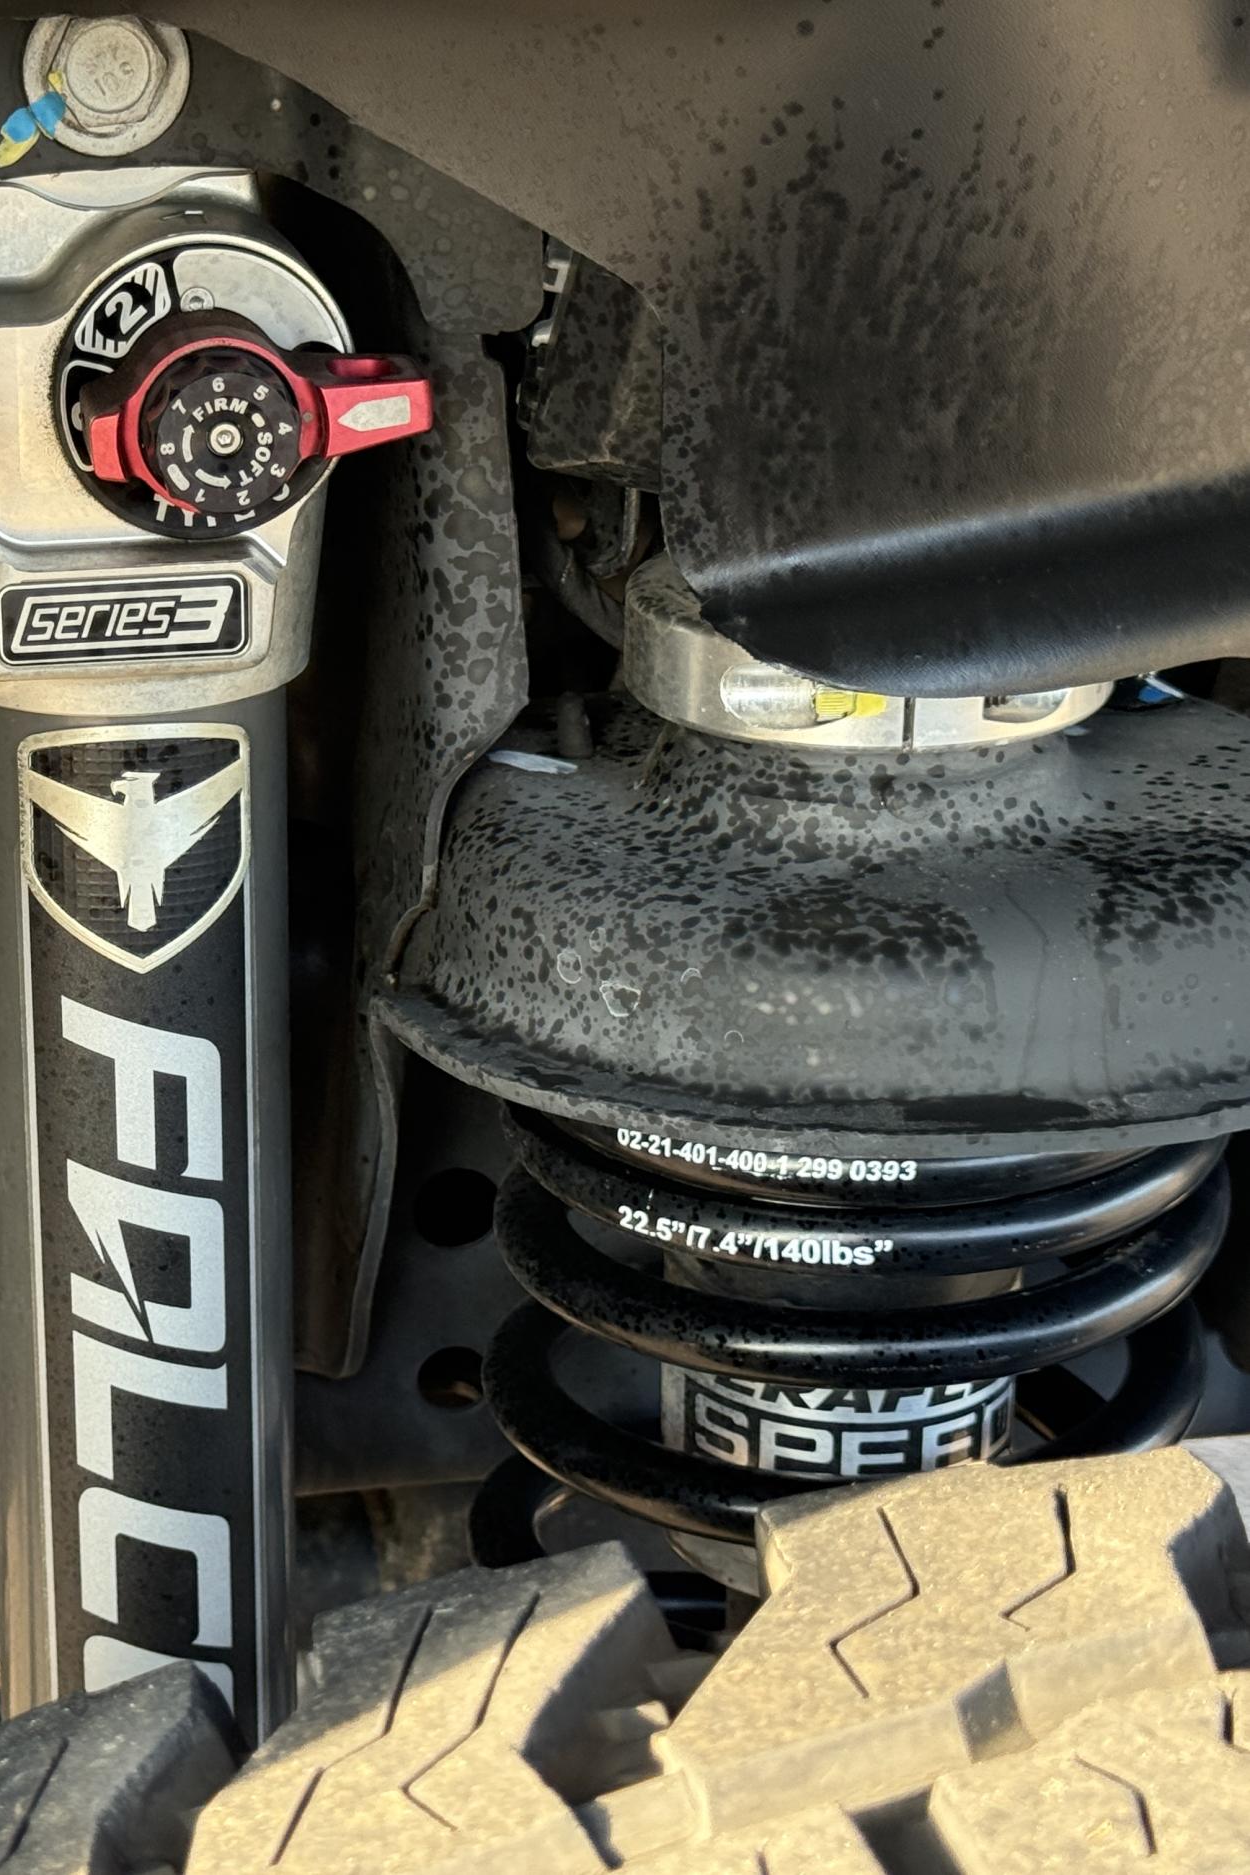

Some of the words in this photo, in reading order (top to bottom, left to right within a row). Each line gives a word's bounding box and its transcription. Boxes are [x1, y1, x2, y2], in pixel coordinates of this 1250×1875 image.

[105, 291, 148, 335] 2
[212, 377, 225, 392] 6
[253, 385, 269, 400] 5
[171, 399, 187, 415] 7
[192, 397, 248, 423] FIRM
[278, 422, 293, 435] 4
[160, 442, 176, 455] 8
[239, 431, 273, 487] SOFT
[796, 1157, 843, 1181] 299
[849, 1160, 918, 1182] 0393
[60, 995, 234, 1698] FALC
